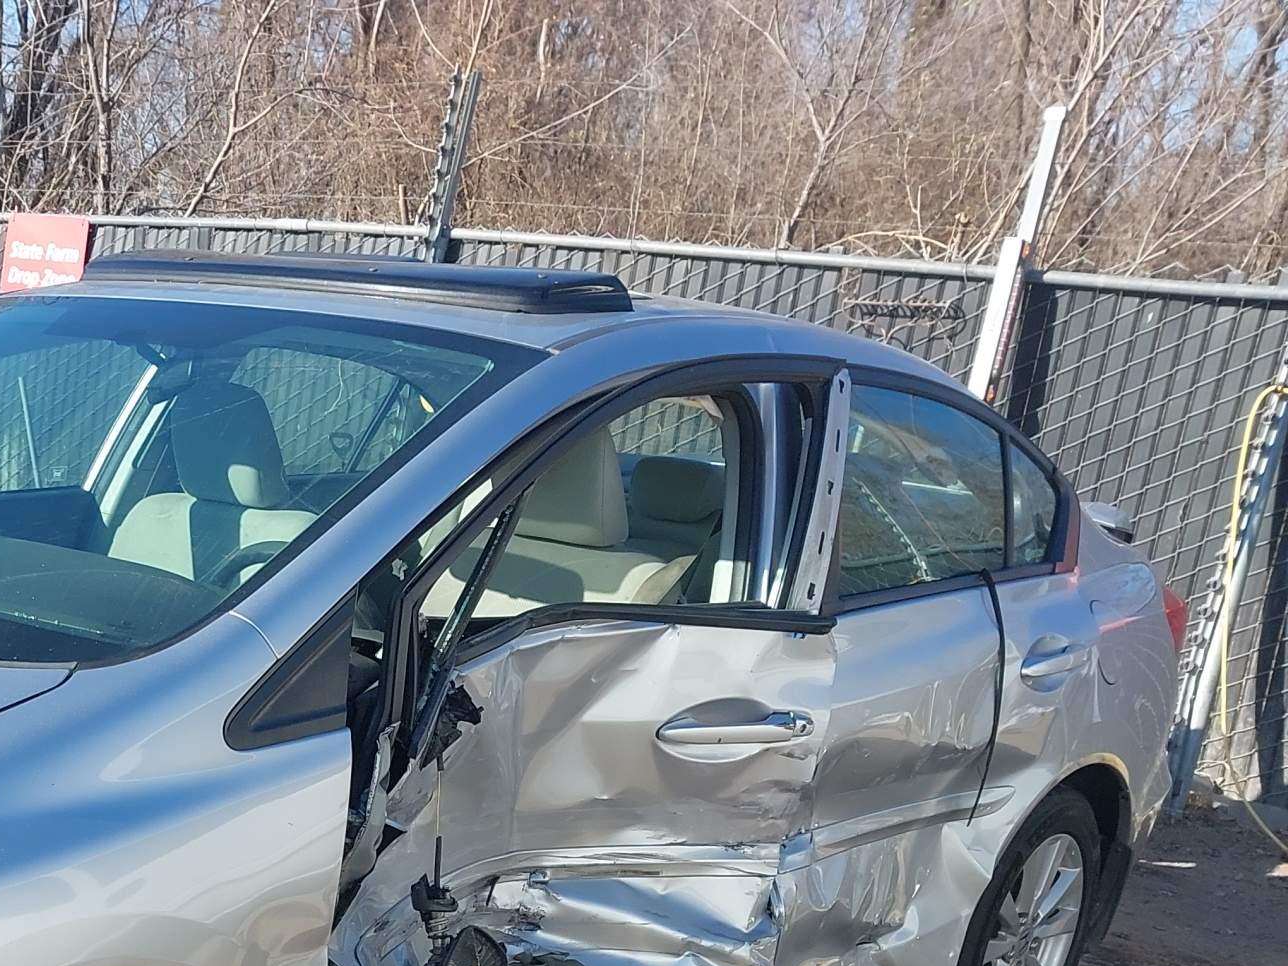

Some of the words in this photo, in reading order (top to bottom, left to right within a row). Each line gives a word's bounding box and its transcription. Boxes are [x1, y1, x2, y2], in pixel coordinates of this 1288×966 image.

[10, 241, 44, 260] State
[45, 243, 79, 263] Farm
[8, 266, 40, 288] Drop
